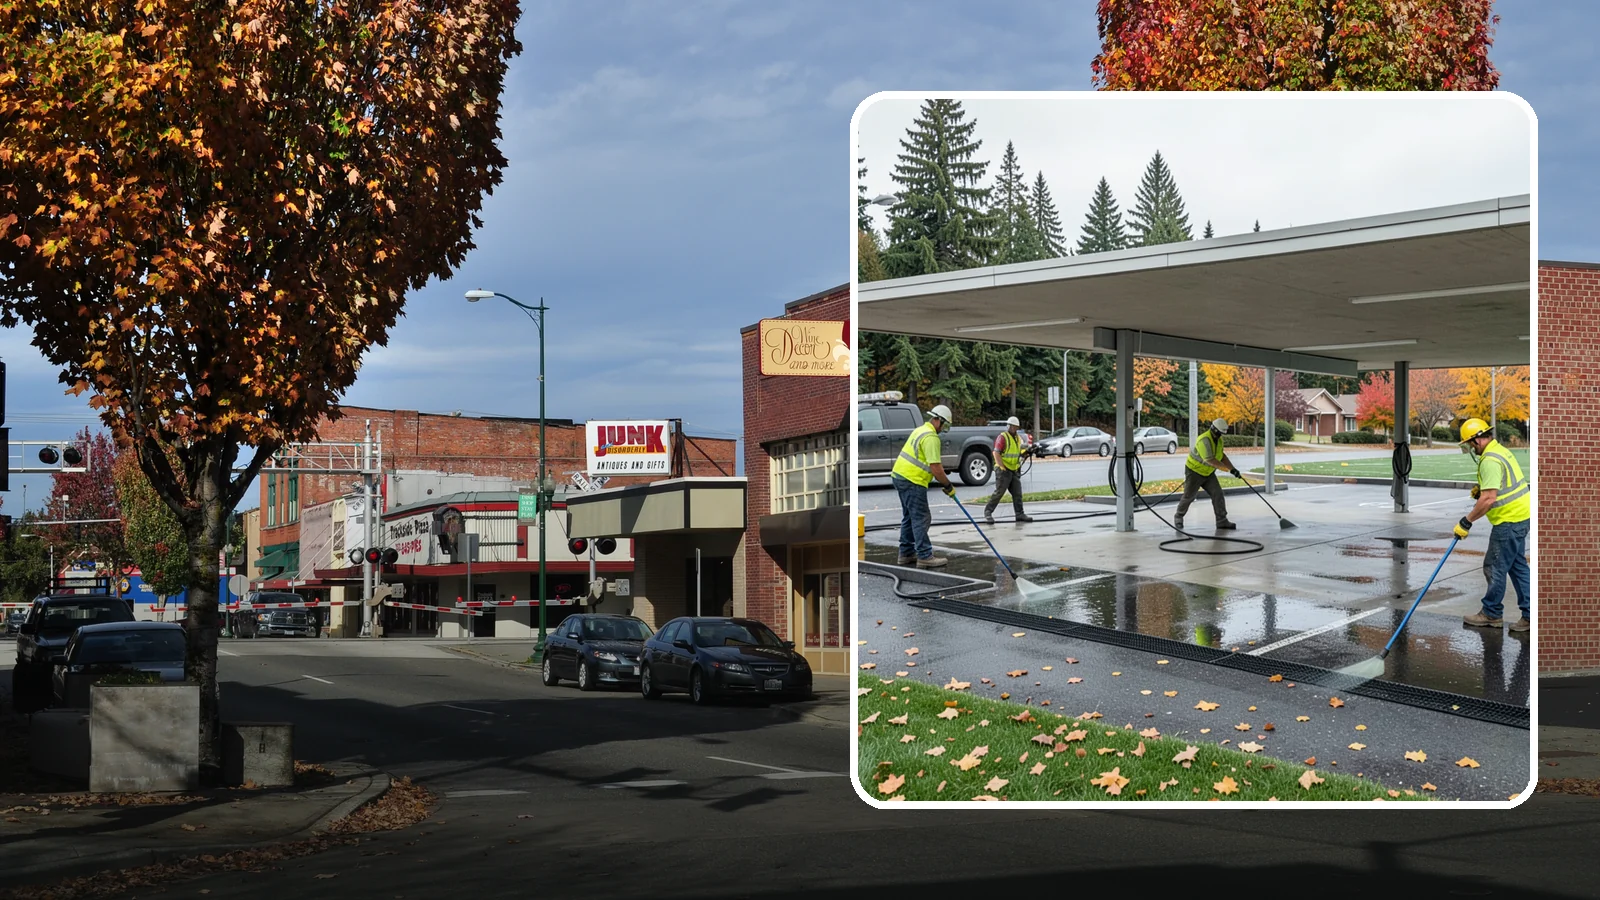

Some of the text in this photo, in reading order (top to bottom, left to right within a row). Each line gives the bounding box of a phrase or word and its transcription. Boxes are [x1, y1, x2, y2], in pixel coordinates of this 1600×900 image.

[596, 425, 665, 457] JUNK
[607, 446, 646, 454] DISORDERLY
[597, 460, 665, 470] ANTIQUES AND GIFTS
[573, 473, 588, 492] RAIL
